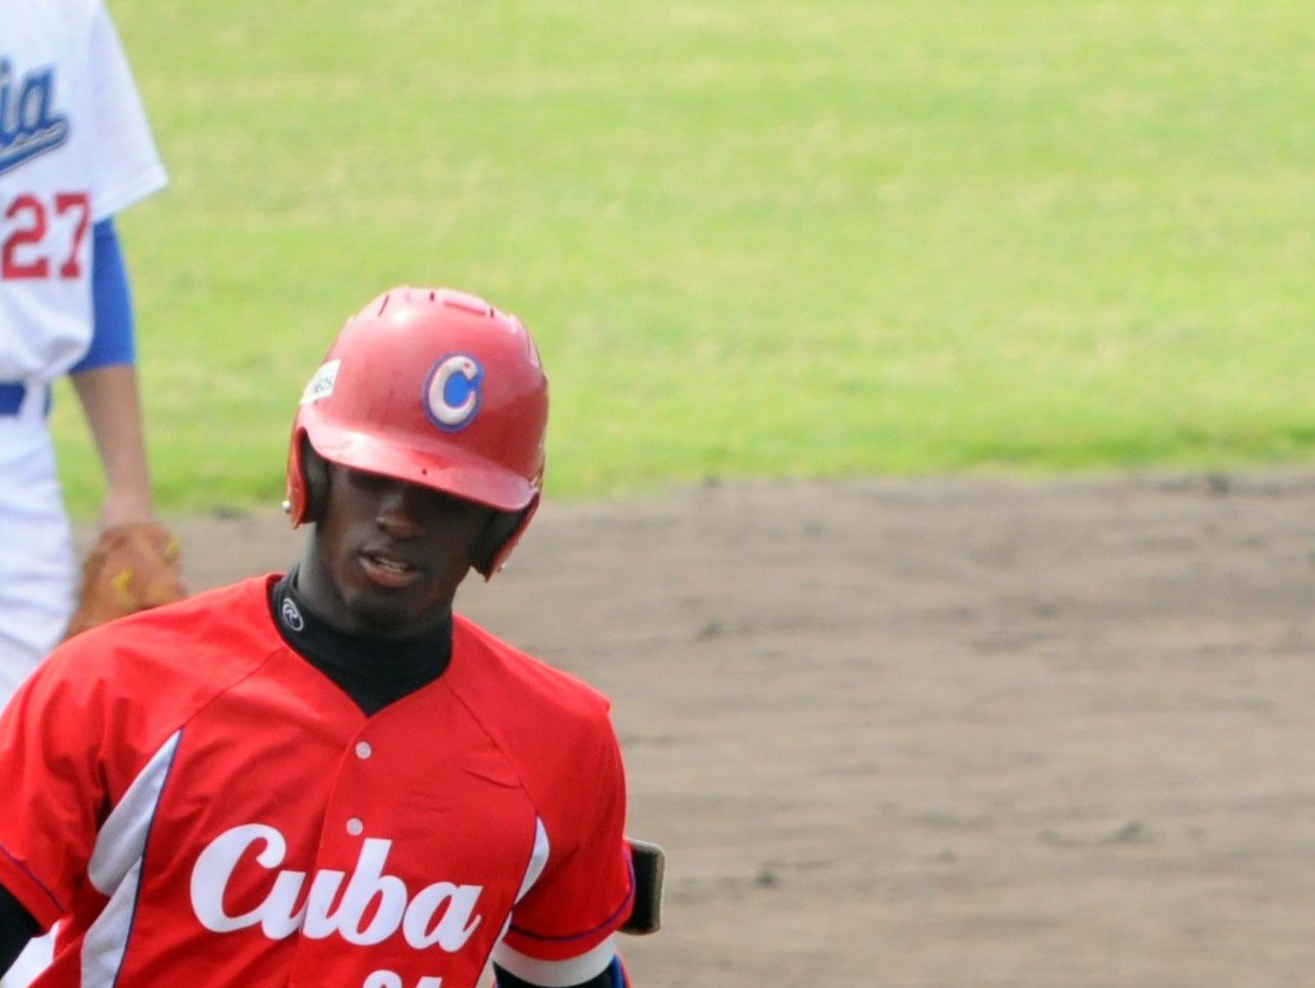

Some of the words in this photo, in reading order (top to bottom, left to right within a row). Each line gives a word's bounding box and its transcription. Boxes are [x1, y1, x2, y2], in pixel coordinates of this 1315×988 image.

[0, 191, 92, 281] 27
[424, 352, 483, 432] C
[190, 823, 483, 953] Cuba
